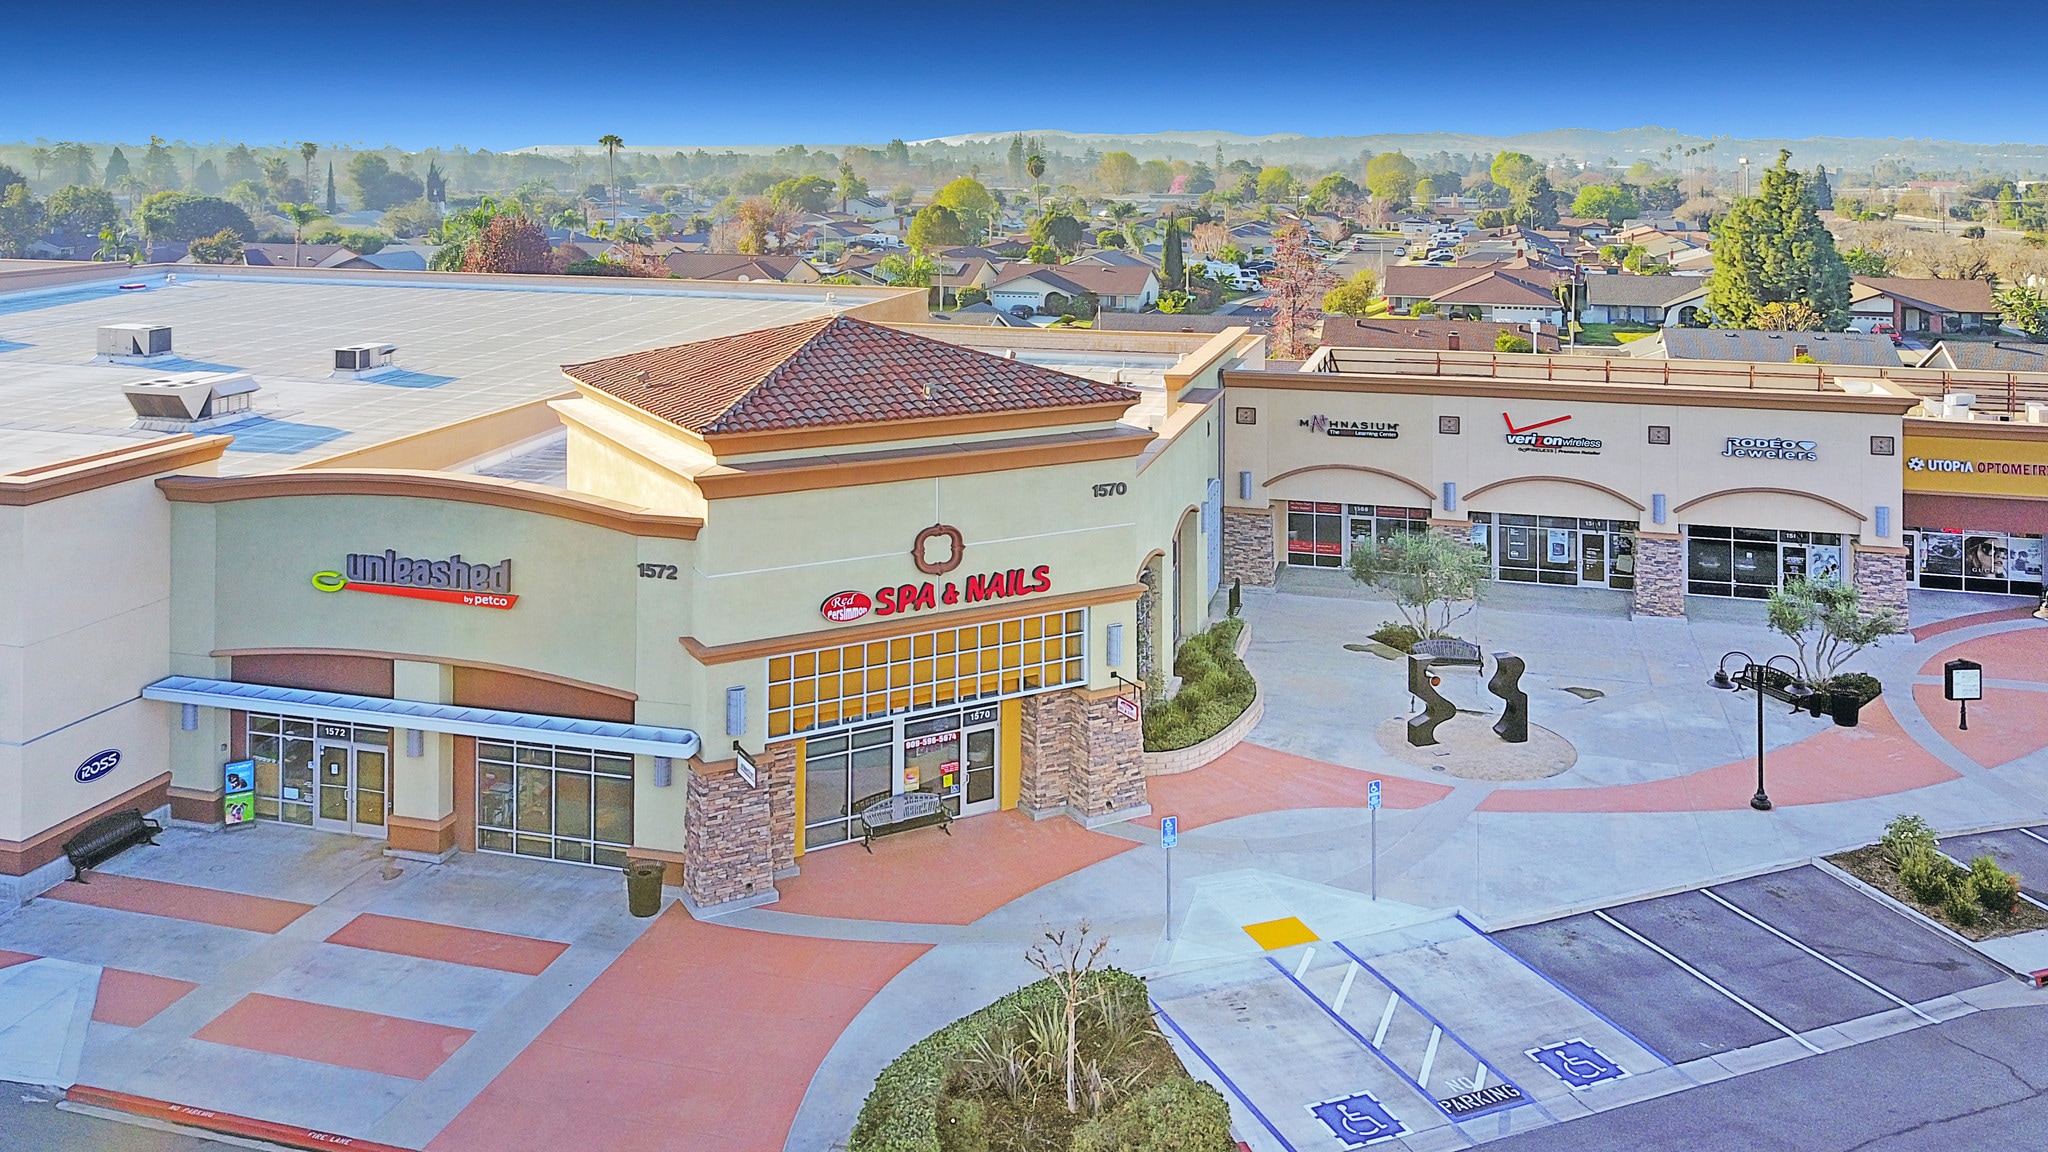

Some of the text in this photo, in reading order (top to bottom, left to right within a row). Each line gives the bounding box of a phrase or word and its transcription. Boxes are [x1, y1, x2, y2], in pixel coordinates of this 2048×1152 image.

[1721, 441, 1817, 461] Jewelers
[1091, 481, 1127, 498] 1570
[346, 548, 512, 594] unleashed
[637, 562, 678, 580] 1572
[875, 565, 1052, 616] SPA & NAILS
[463, 594, 508, 606] by petco
[831, 593, 858, 608] Red
[970, 710, 991, 721] 1570
[325, 727, 346, 737] 1572
[81, 752, 117, 779] ROSS
[1444, 1076, 1476, 1093] NO
[167, 1103, 182, 1111] NO
[1437, 1084, 1521, 1115] PARKING
[307, 1131, 353, 1146] FIRE LANE
